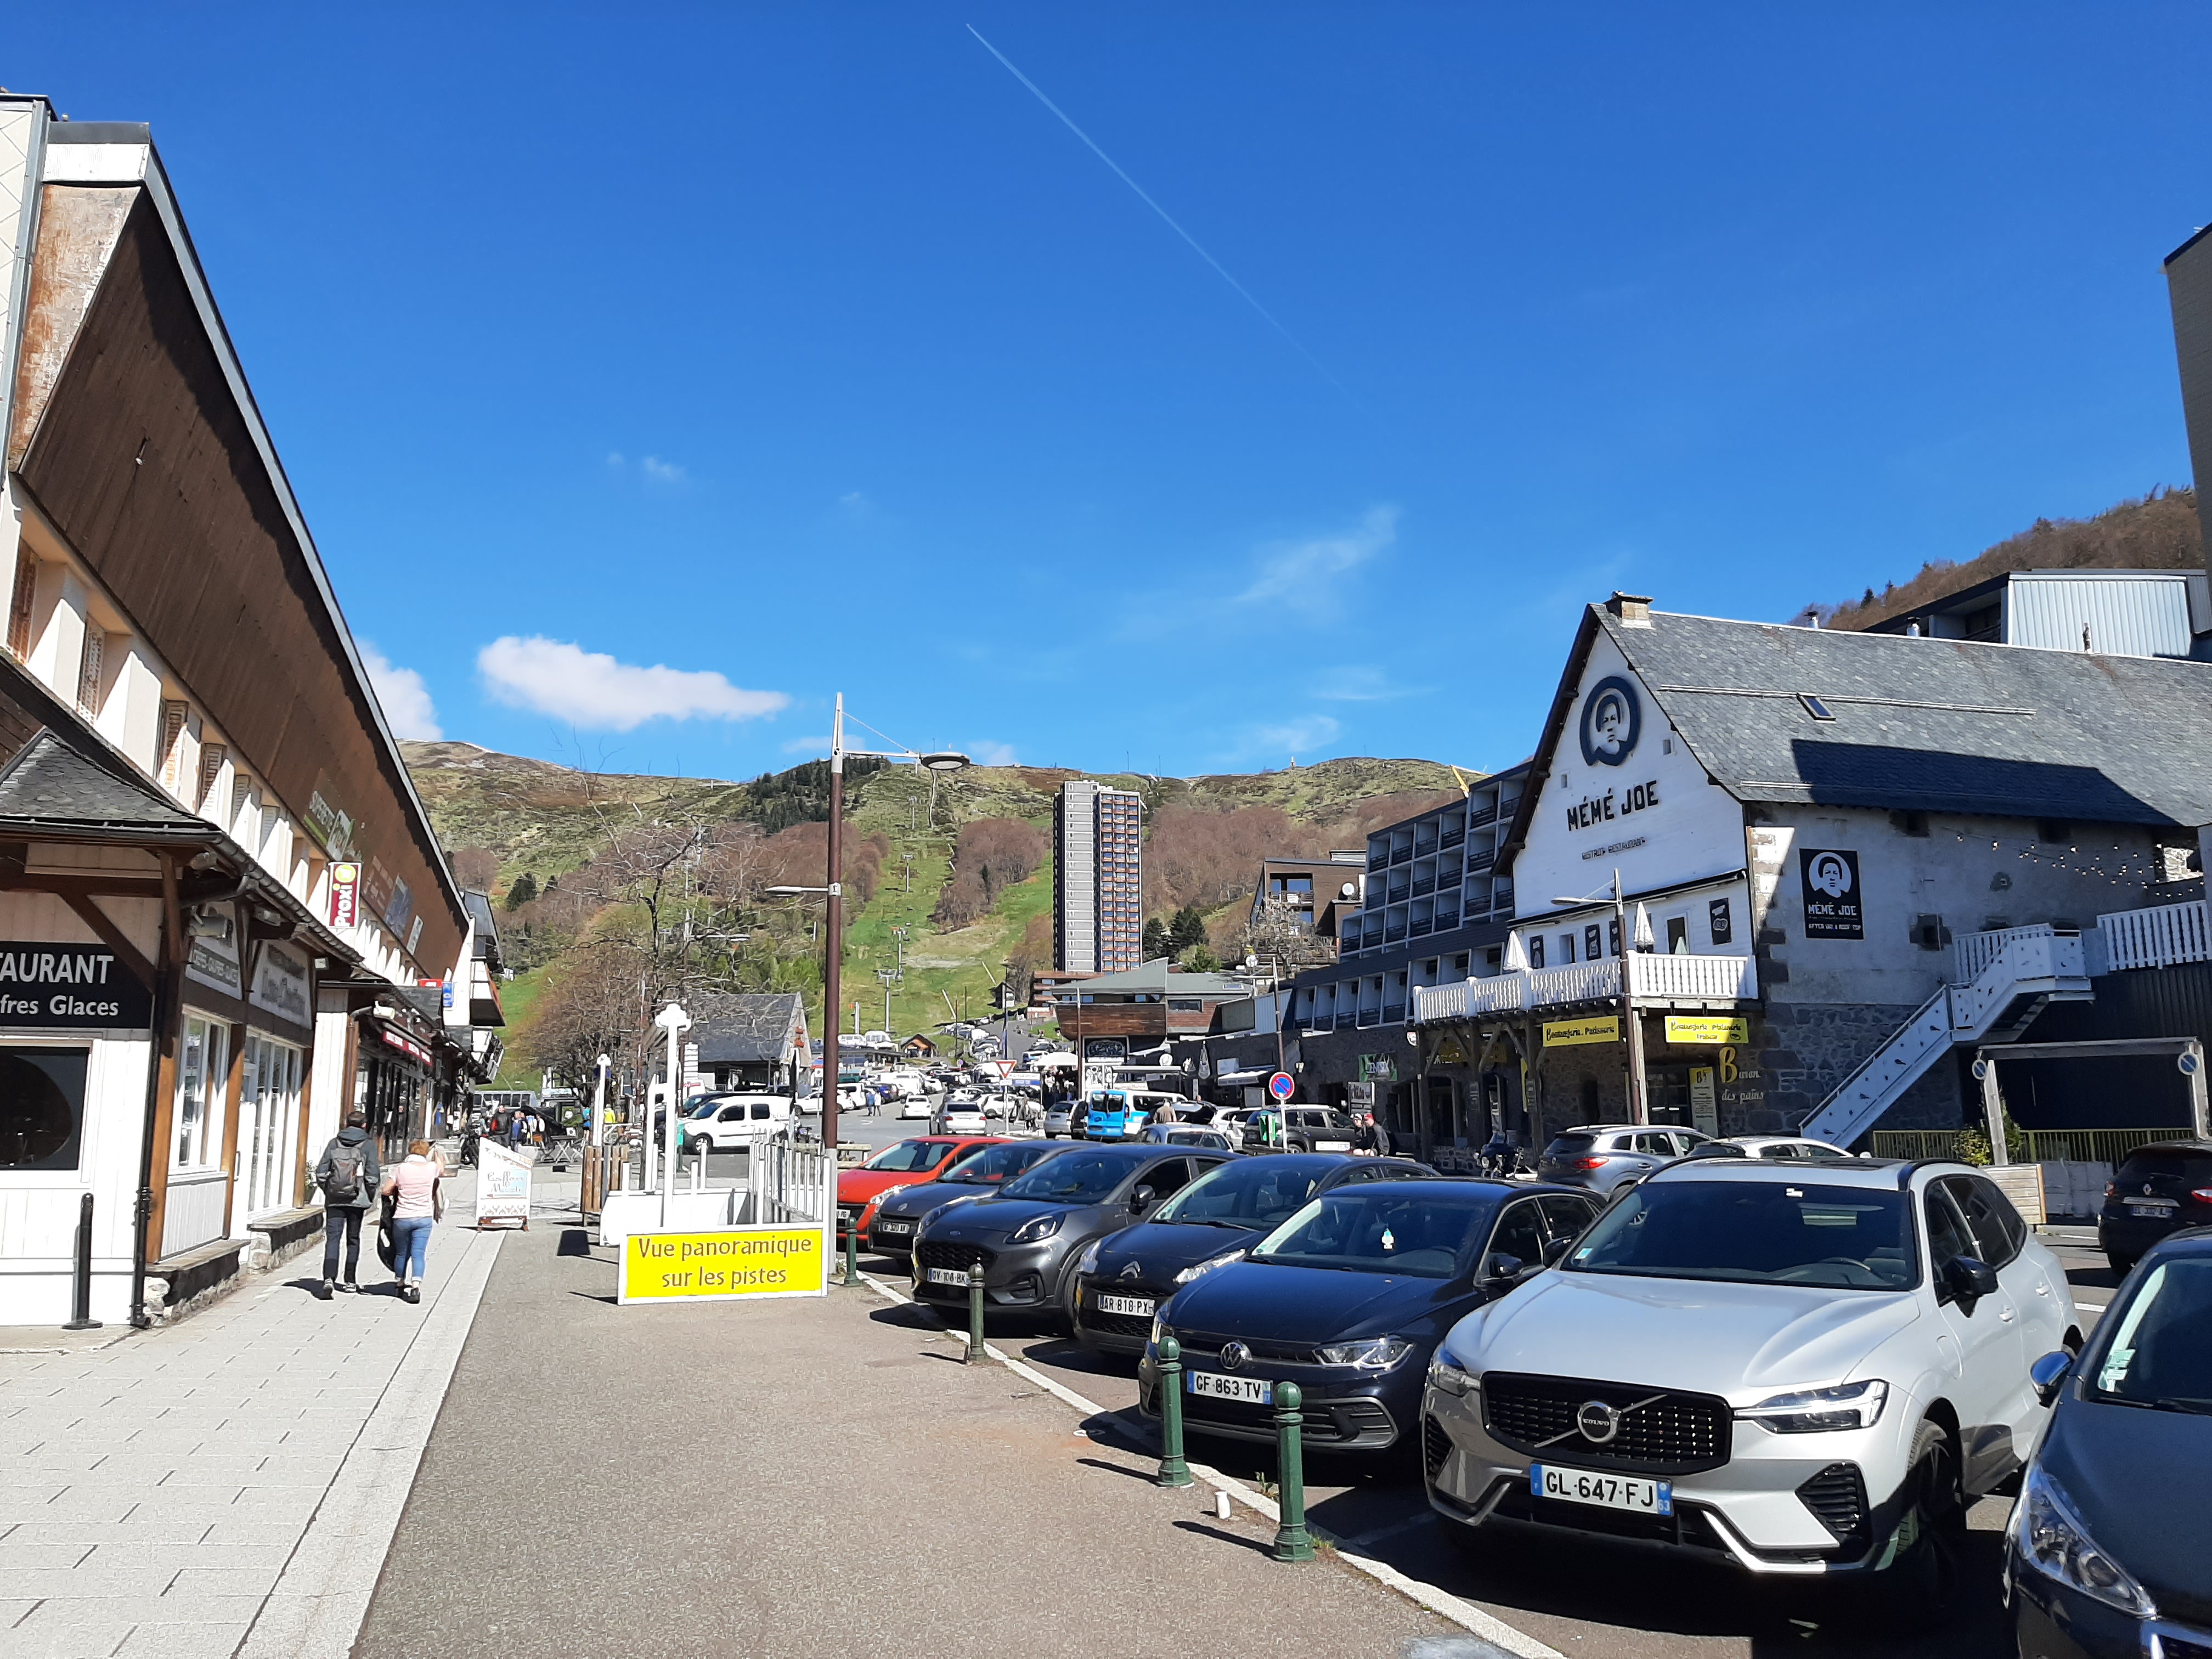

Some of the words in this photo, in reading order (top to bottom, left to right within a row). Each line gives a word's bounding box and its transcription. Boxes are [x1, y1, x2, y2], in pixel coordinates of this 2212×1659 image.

[1567, 787, 1615, 832] MÉMÉ
[1621, 780, 1659, 815] JOE
[1838, 905, 1857, 916] JOE
[0, 952, 114, 984] AURANT
[49, 995, 119, 1016] Glaces
[639, 1238, 675, 1258] Vue
[681, 1235, 811, 1261] panoramique
[662, 1272, 693, 1288] sur
[699, 1266, 725, 1286] les
[731, 1266, 787, 1289] pistes
[1658, 1499, 1671, 1511] 63
